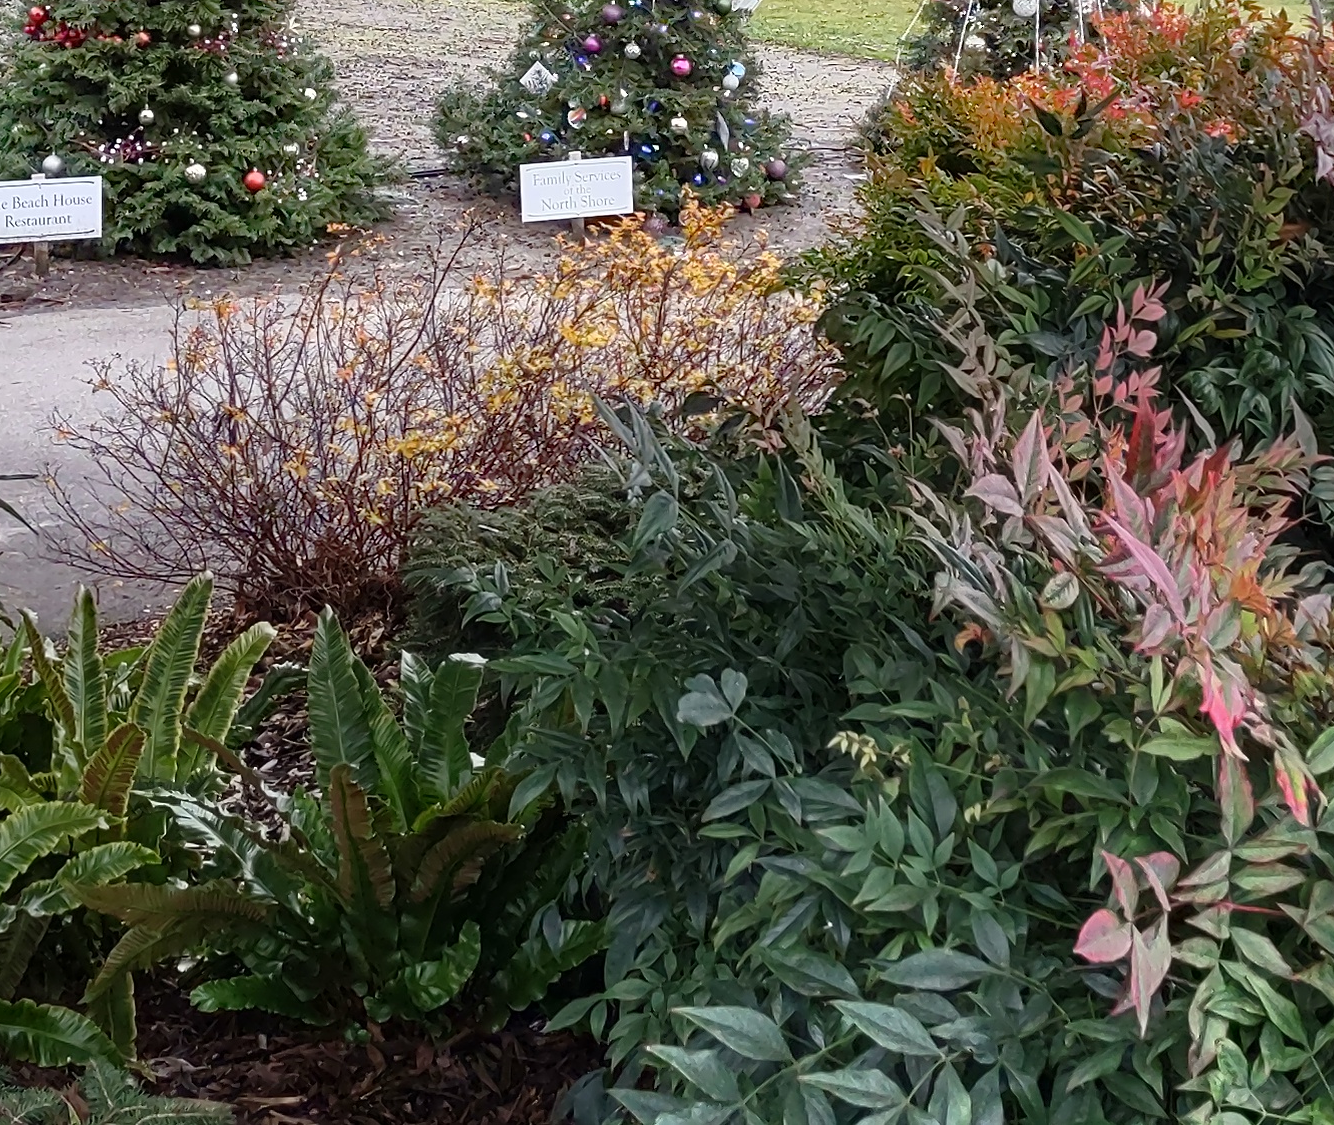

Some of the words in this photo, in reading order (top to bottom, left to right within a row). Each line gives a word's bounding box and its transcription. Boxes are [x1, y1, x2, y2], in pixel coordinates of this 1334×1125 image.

[532, 171, 571, 186] Family
[574, 170, 621, 183] Services
[564, 185, 574, 195] of
[576, 184, 592, 194] the
[12, 194, 48, 210] Beach
[53, 194, 93, 207] House
[541, 196, 577, 211] North
[580, 195, 615, 208] Shore
[5, 214, 72, 228] Restaurant
